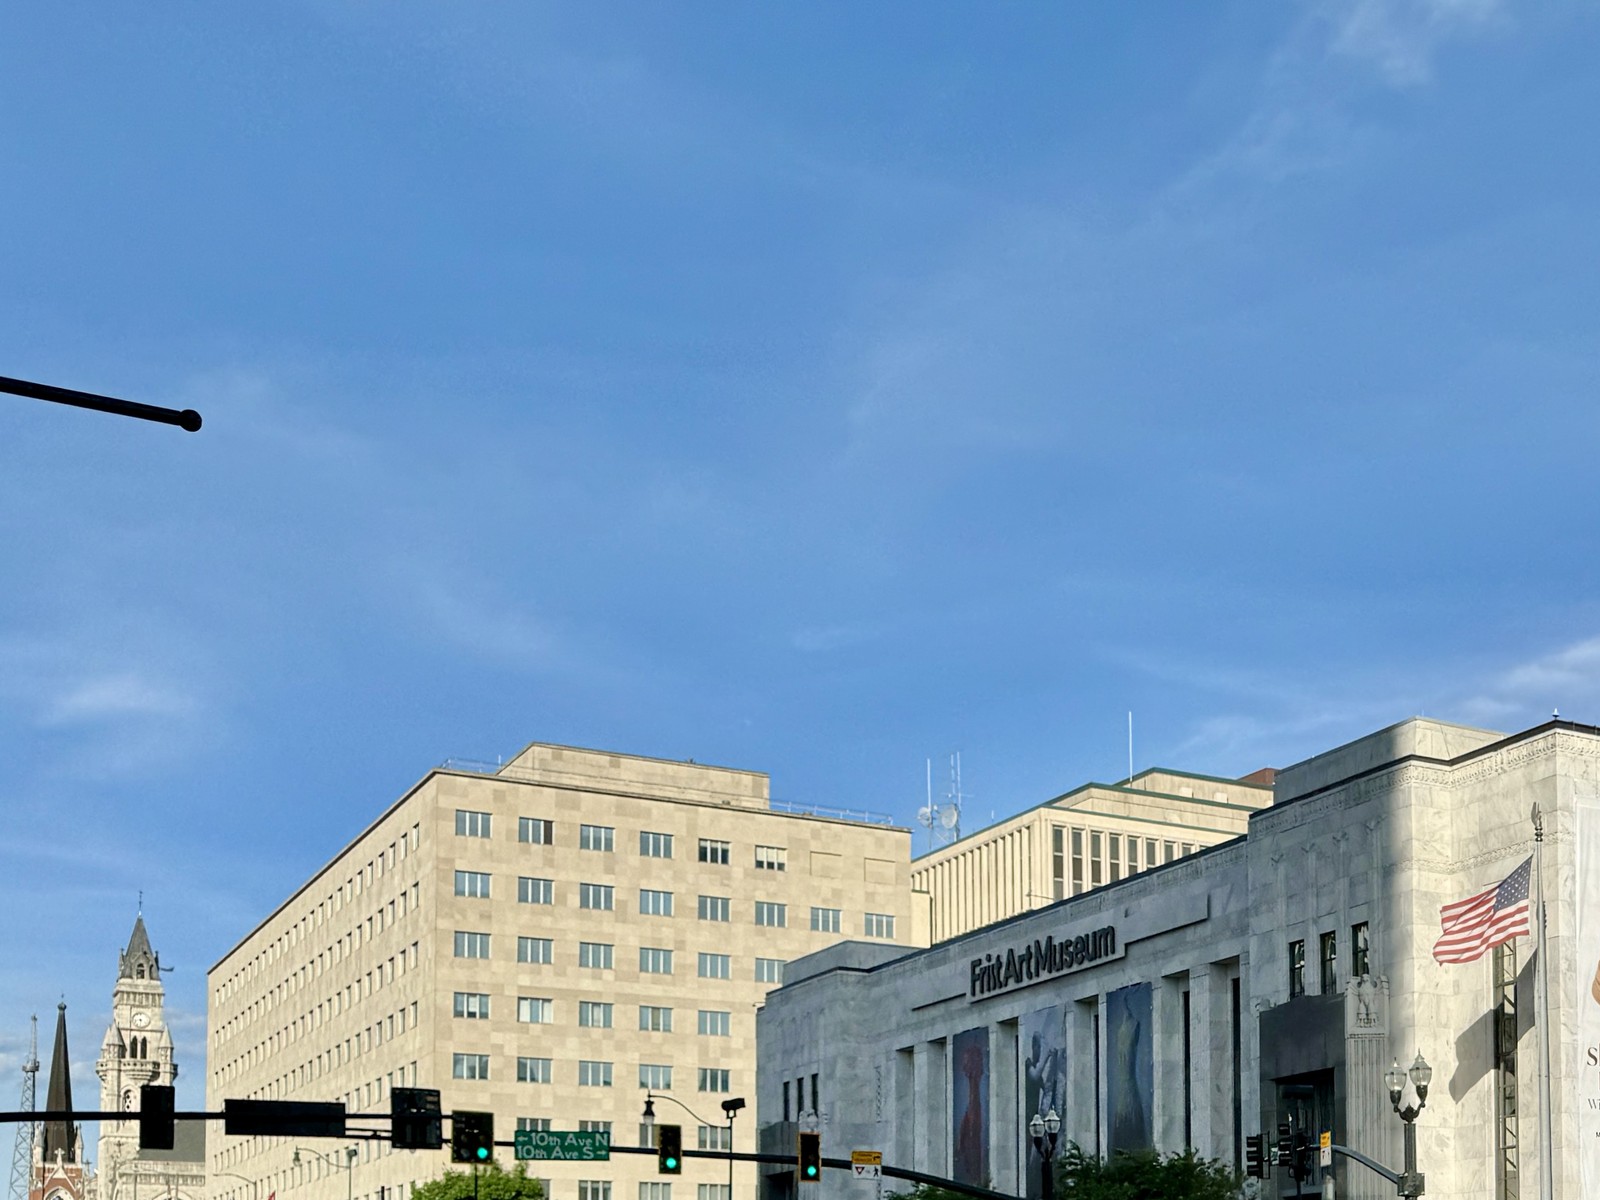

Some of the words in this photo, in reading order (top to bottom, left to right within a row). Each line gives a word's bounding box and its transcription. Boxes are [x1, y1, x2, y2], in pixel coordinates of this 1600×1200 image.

[970, 953, 1003, 997] Frist
[1003, 944, 1033, 988] Art
[1034, 925, 1116, 978] Museum
[530, 1132, 560, 1146] 10th
[565, 1133, 592, 1147] Ave
[595, 1133, 608, 1146] N
[517, 1145, 547, 1159] 10th
[551, 1146, 579, 1159] Ave
[583, 1146, 594, 1159] S
